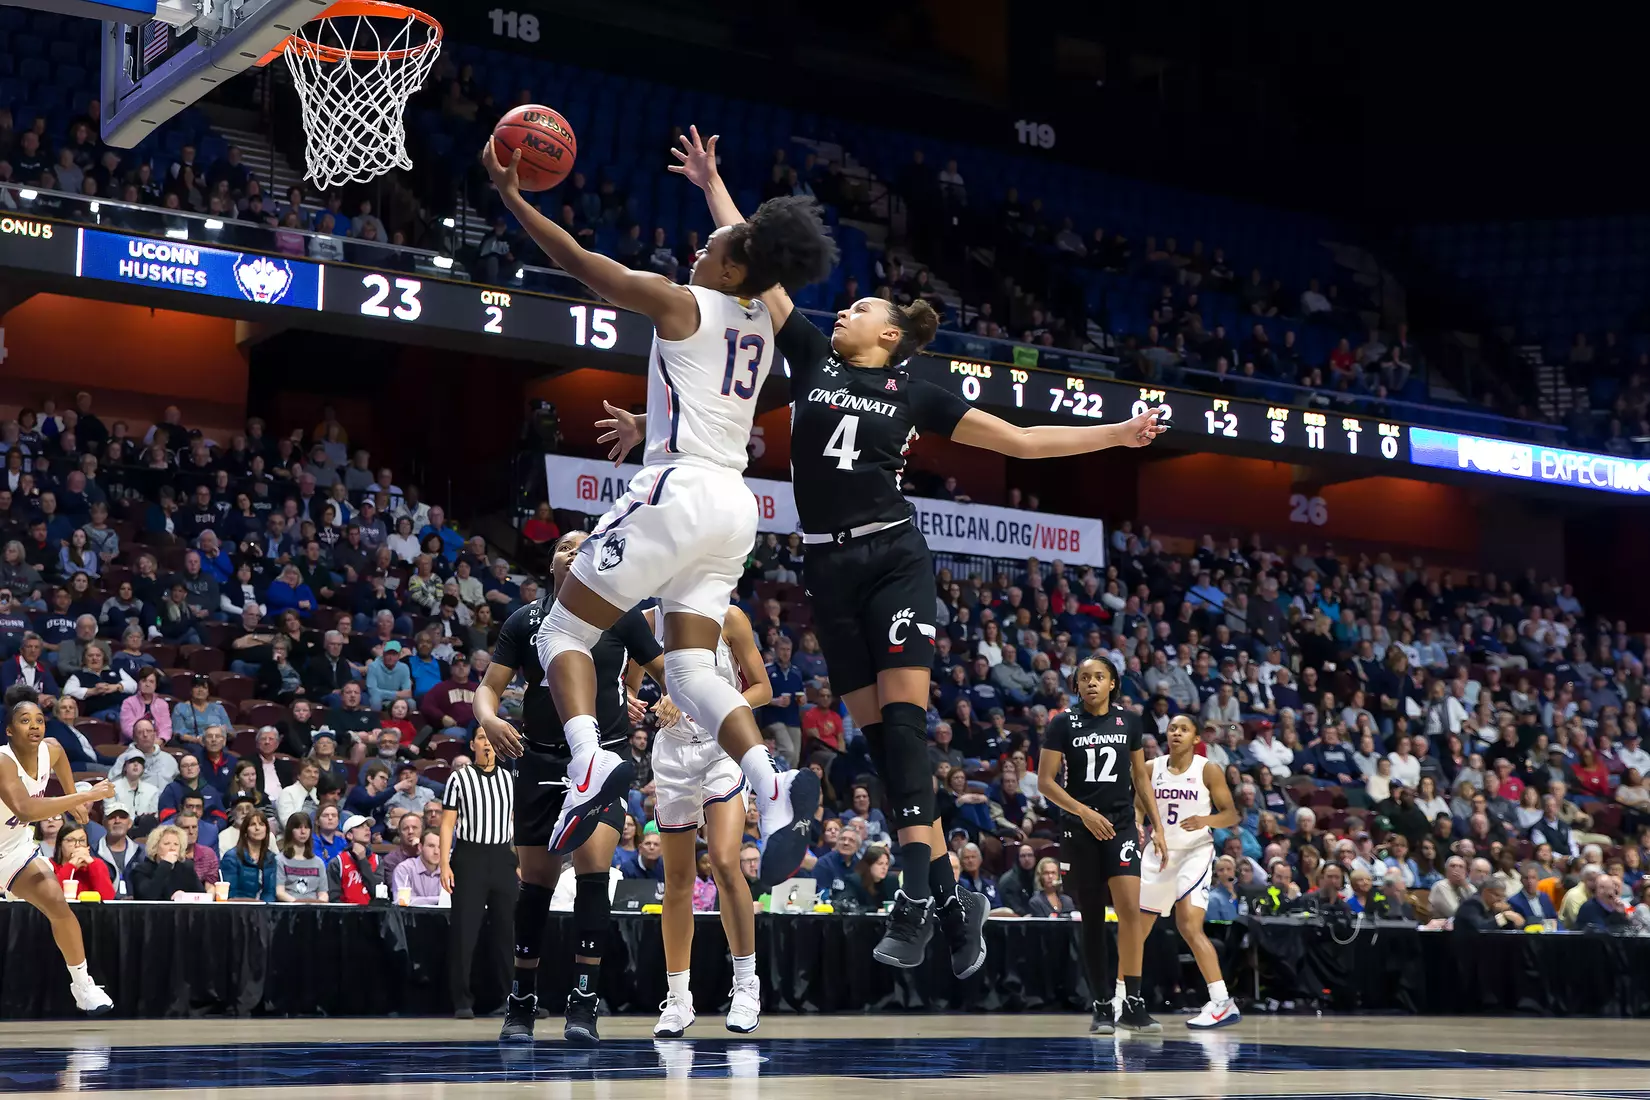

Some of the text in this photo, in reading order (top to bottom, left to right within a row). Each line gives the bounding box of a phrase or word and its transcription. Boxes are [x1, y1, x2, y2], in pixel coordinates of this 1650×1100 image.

[488, 8, 540, 43] 118
[523, 110, 573, 147] Wilson
[1014, 119, 1056, 149] 119
[521, 133, 563, 161] NCAA
[0, 218, 53, 239] ONUS
[128, 240, 200, 266] UCONN
[119, 259, 208, 288] HUSKIES
[360, 273, 422, 322] 23
[480, 290, 510, 308] QTR
[483, 306, 502, 334] 2
[569, 305, 618, 350] 15
[720, 327, 765, 400] 13
[950, 360, 992, 379] FOULS
[1010, 369, 1028, 384] TO
[961, 376, 981, 401] 0
[1012, 383, 1024, 408] 1
[1066, 377, 1085, 391] FG
[807, 387, 898, 418] CINCINNATI
[1049, 388, 1103, 419] 7-22
[1213, 399, 1230, 413] FT
[1267, 407, 1290, 421] AST
[1204, 410, 1238, 437] 1-2
[1270, 420, 1286, 443] 5
[750, 426, 766, 459] 5
[822, 414, 862, 470] 4
[1305, 425, 1325, 450] 11
[1347, 431, 1358, 454] 1
[1380, 436, 1399, 459] 0
[1289, 494, 1328, 526] 26
[912, 511, 1081, 553] ERICAN.ORG/WBB
[1072, 733, 1127, 748] CINCINNATI
[1084, 746, 1119, 783] 12
[1154, 788, 1199, 801] UCONN
[1166, 802, 1180, 825] 5
